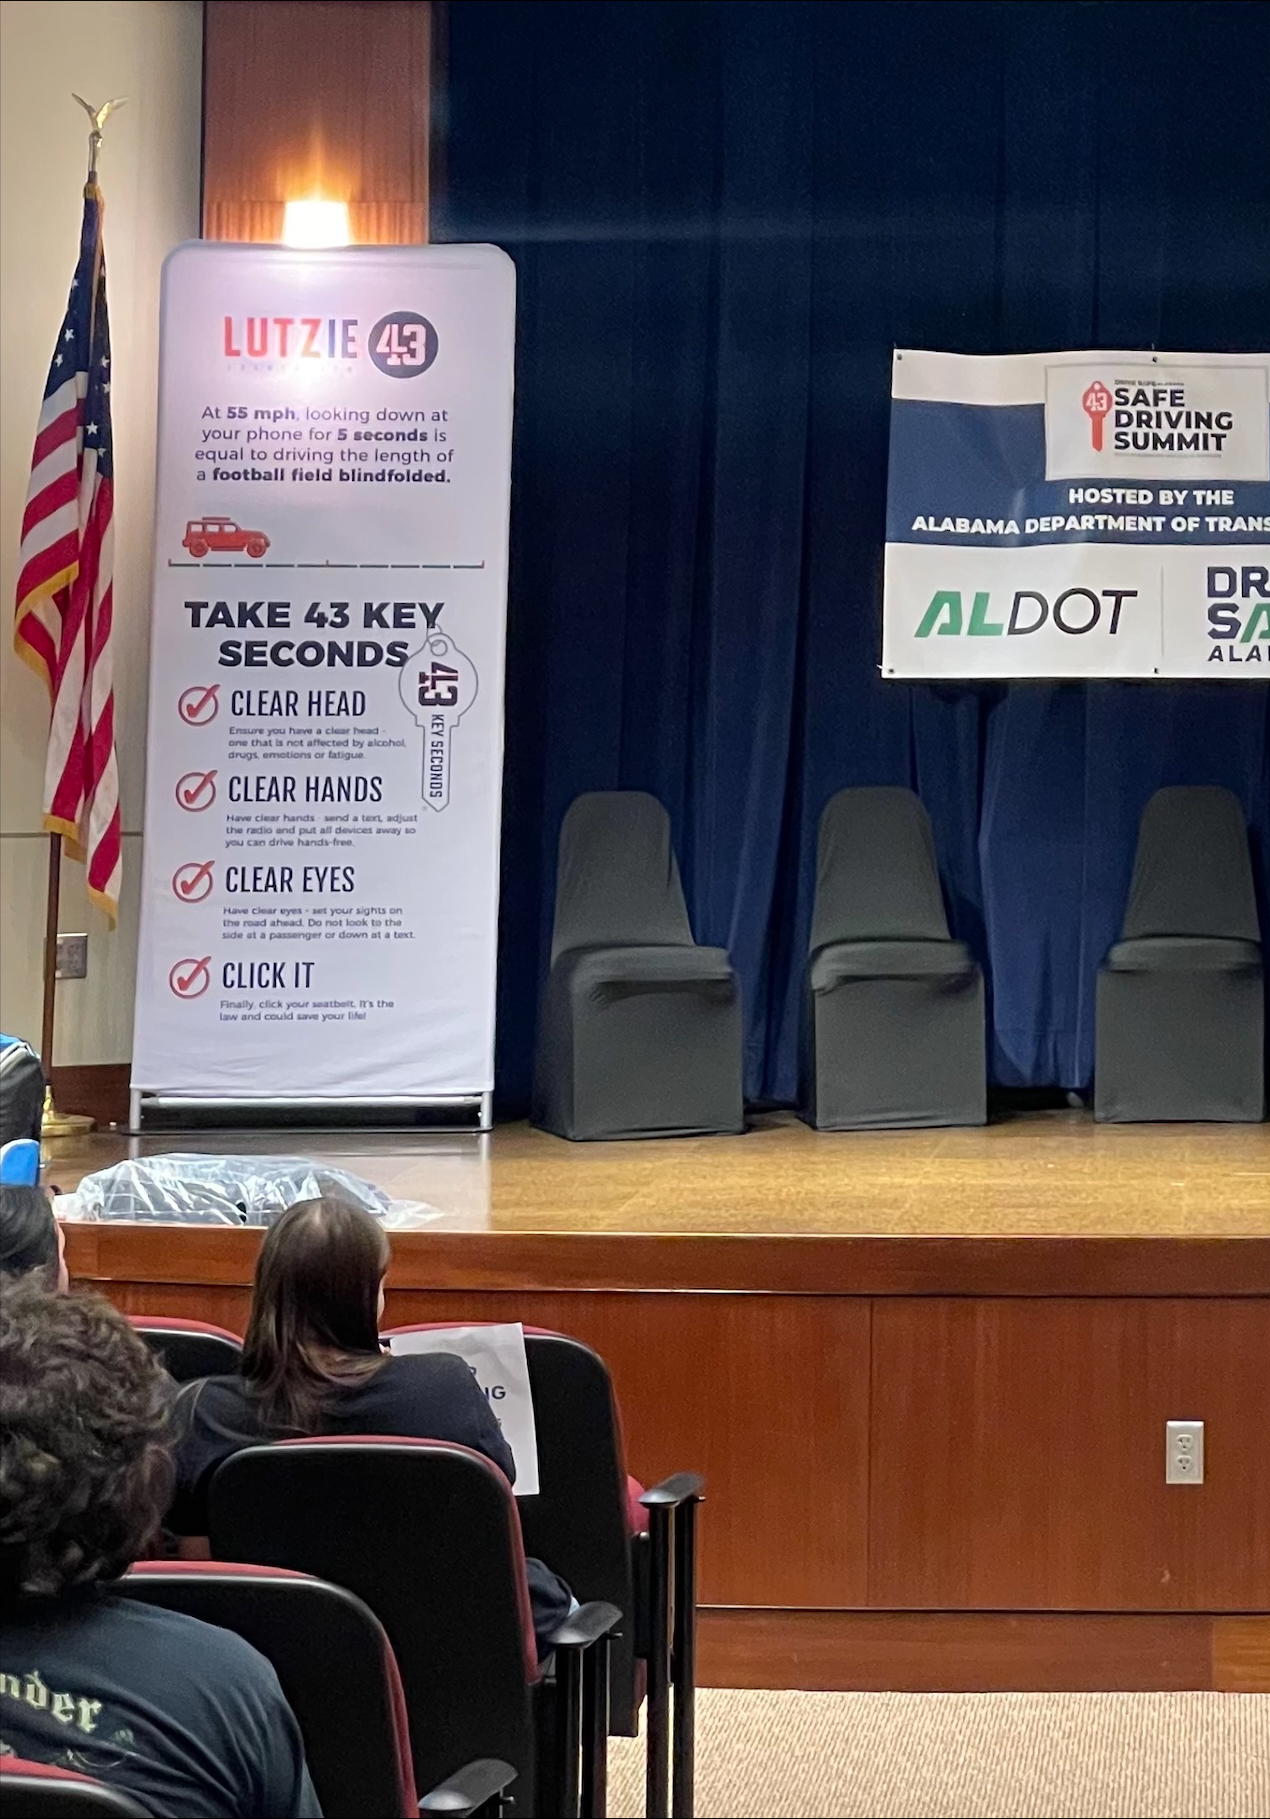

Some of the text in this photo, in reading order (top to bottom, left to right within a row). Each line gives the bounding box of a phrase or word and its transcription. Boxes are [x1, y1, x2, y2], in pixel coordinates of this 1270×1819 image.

[224, 316, 359, 359] LUTZIE
[376, 324, 427, 366] 43
[1085, 392, 1108, 411] 43
[1114, 388, 1185, 407] SAFE
[201, 406, 221, 419] At
[227, 406, 248, 419] 55
[306, 406, 370, 424] looking
[376, 408, 425, 421] down
[431, 410, 448, 422] at
[1115, 410, 1233, 430] DRIVING
[202, 426, 447, 443] your phone for 5 seconds is
[1114, 432, 1227, 451] SUMMIT
[195, 447, 454, 465] equal to driving the length of
[196, 467, 451, 483] a football field blindfolded.
[1069, 488, 1235, 505] HOSTED BY THE
[911, 515, 1019, 534] ALABAMA
[1026, 515, 1166, 534] DEPARTMENT
[1171, 516, 1200, 533] OF
[184, 602, 445, 629] TAKE 43 KEY
[914, 587, 1139, 638] ALDOT
[218, 640, 409, 667] SECONDS
[418, 661, 458, 707] 43
[231, 690, 366, 717] CLEAR HEAD
[229, 727, 264, 735] Ensure
[267, 728, 286, 737] you
[289, 727, 313, 735] have
[325, 727, 350, 735] clear
[353, 727, 379, 735] head
[431, 714, 444, 737] KEY
[251, 739, 272, 747] that
[276, 739, 283, 747] is
[286, 739, 303, 747] not
[307, 739, 349, 747] affected
[352, 739, 364, 749] by
[262, 751, 311, 759] emotions
[429, 741, 444, 798] SECONDS
[228, 776, 383, 802] CLEAR HANDS
[226, 814, 251, 822] Have
[255, 814, 279, 822] clear
[283, 814, 315, 822] hands
[324, 814, 349, 822] send
[386, 814, 417, 824] adjust
[226, 826, 243, 834] the
[246, 826, 272, 834] radio
[276, 826, 295, 834] and
[299, 827, 316, 836] put
[320, 826, 332, 834] all
[335, 826, 373, 834] devices
[376, 828, 401, 836] away
[225, 839, 244, 848] you
[247, 839, 266, 847] can
[269, 838, 294, 847] drive
[225, 866, 355, 893] CLEAR EYES
[223, 907, 248, 915] Have
[252, 907, 277, 915] clear
[280, 908, 302, 916] eyes
[312, 907, 327, 915] set
[330, 908, 353, 917] your
[356, 907, 386, 916] sights
[223, 919, 240, 927] the
[243, 919, 267, 927] road
[308, 919, 322, 927] Do
[325, 919, 343, 927] not
[346, 919, 368, 927] look
[371, 919, 382, 927] to
[385, 919, 402, 927] the
[222, 931, 243, 939] side
[246, 931, 257, 939] at
[269, 932, 322, 941] passenger
[339, 931, 368, 939] down
[371, 931, 381, 939] at
[222, 962, 315, 989] CLICK IT
[259, 1000, 283, 1008] click
[286, 1002, 309, 1010] your
[377, 1000, 395, 1008] the
[219, 1012, 238, 1021] law
[241, 1012, 261, 1020] and
[264, 1012, 294, 1020] could
[321, 1013, 344, 1022] your
